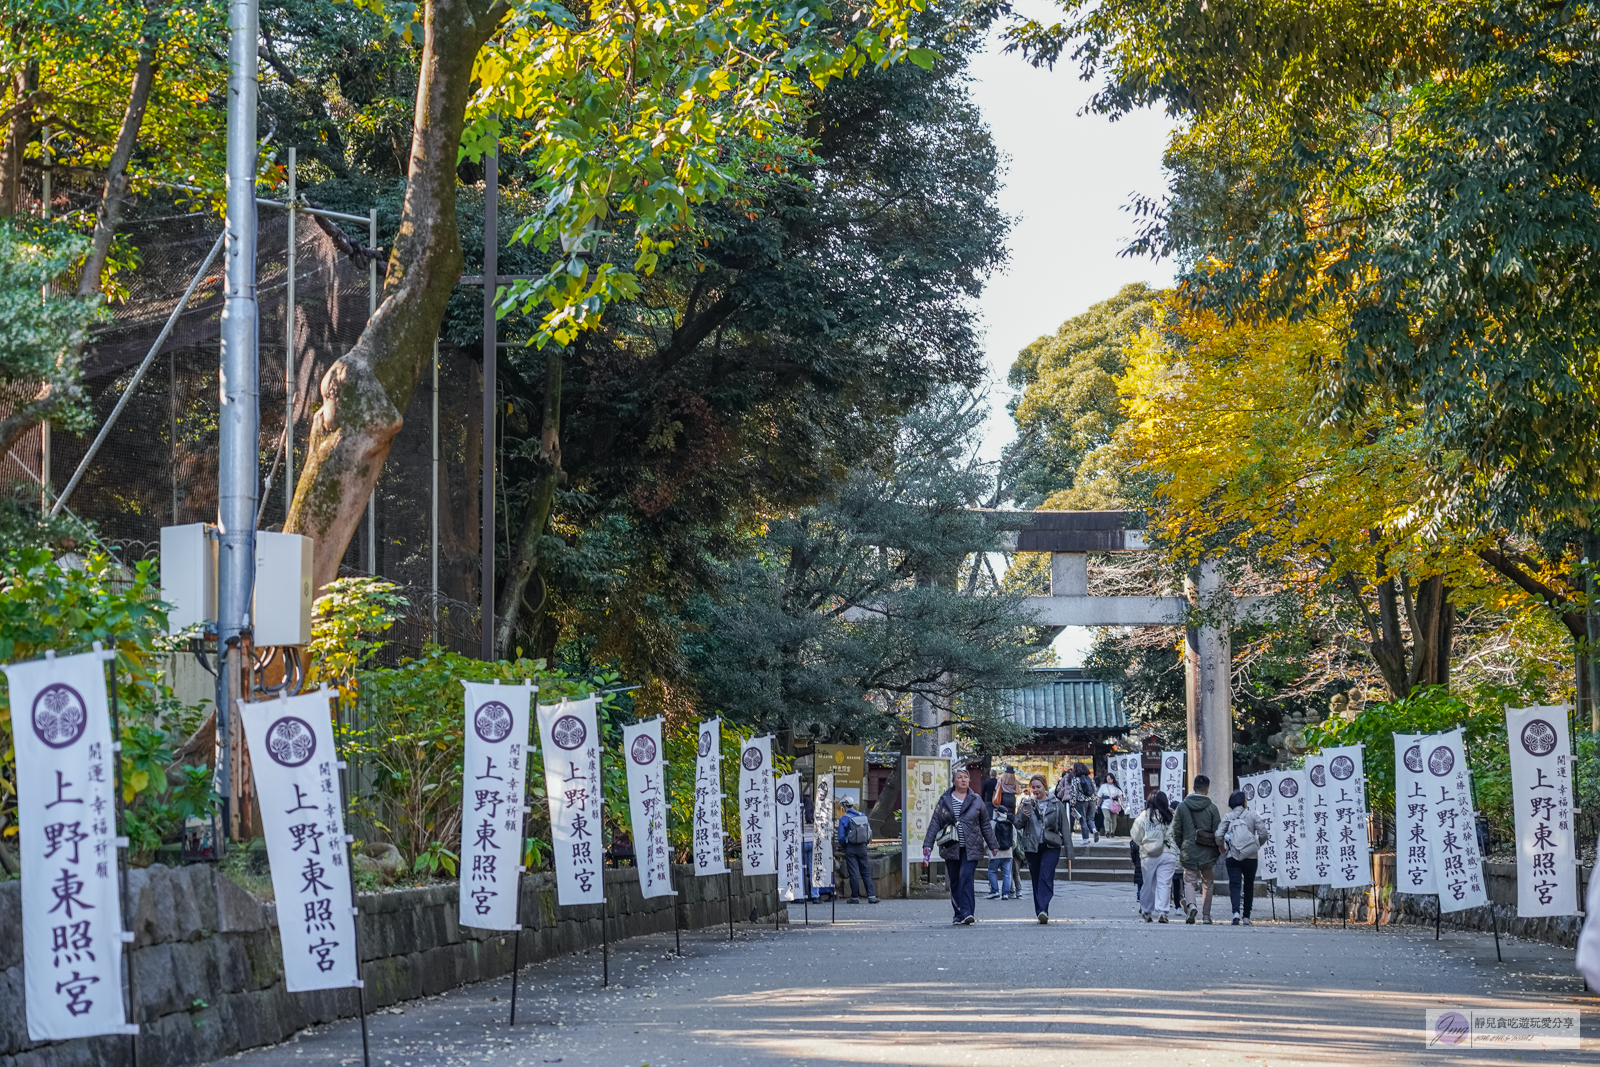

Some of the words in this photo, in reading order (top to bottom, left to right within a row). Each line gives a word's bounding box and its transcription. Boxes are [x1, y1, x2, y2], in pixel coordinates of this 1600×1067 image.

[87, 741, 110, 879] 開運・幸福祈願
[318, 761, 344, 867] 開運・幸福祈願
[504, 743, 521, 832] 開運・幸福祈願
[563, 761, 596, 893] 上野東照宮
[586, 747, 600, 820] 健康長寿祈願
[695, 766, 712, 869] 上野東照宮
[744, 778, 764, 868] 上野東照宮
[1129, 773, 1141, 815] 上野東照宮
[1313, 793, 1331, 878] 上野東照宮
[1335, 788, 1360, 882] 上野東照宮
[1407, 781, 1429, 886] 上野東照宮
[1556, 754, 1570, 832] 開運・幸福祈願
[285, 782, 340, 974] 上野東照宮
[471, 756, 504, 916] 上野東照宮
[1282, 804, 1302, 881] 上野東照宮
[1435, 785, 1468, 902] 上野東照宮
[1529, 767, 1559, 906] 上野東照宮
[44, 769, 101, 1017] 上野東照宮
